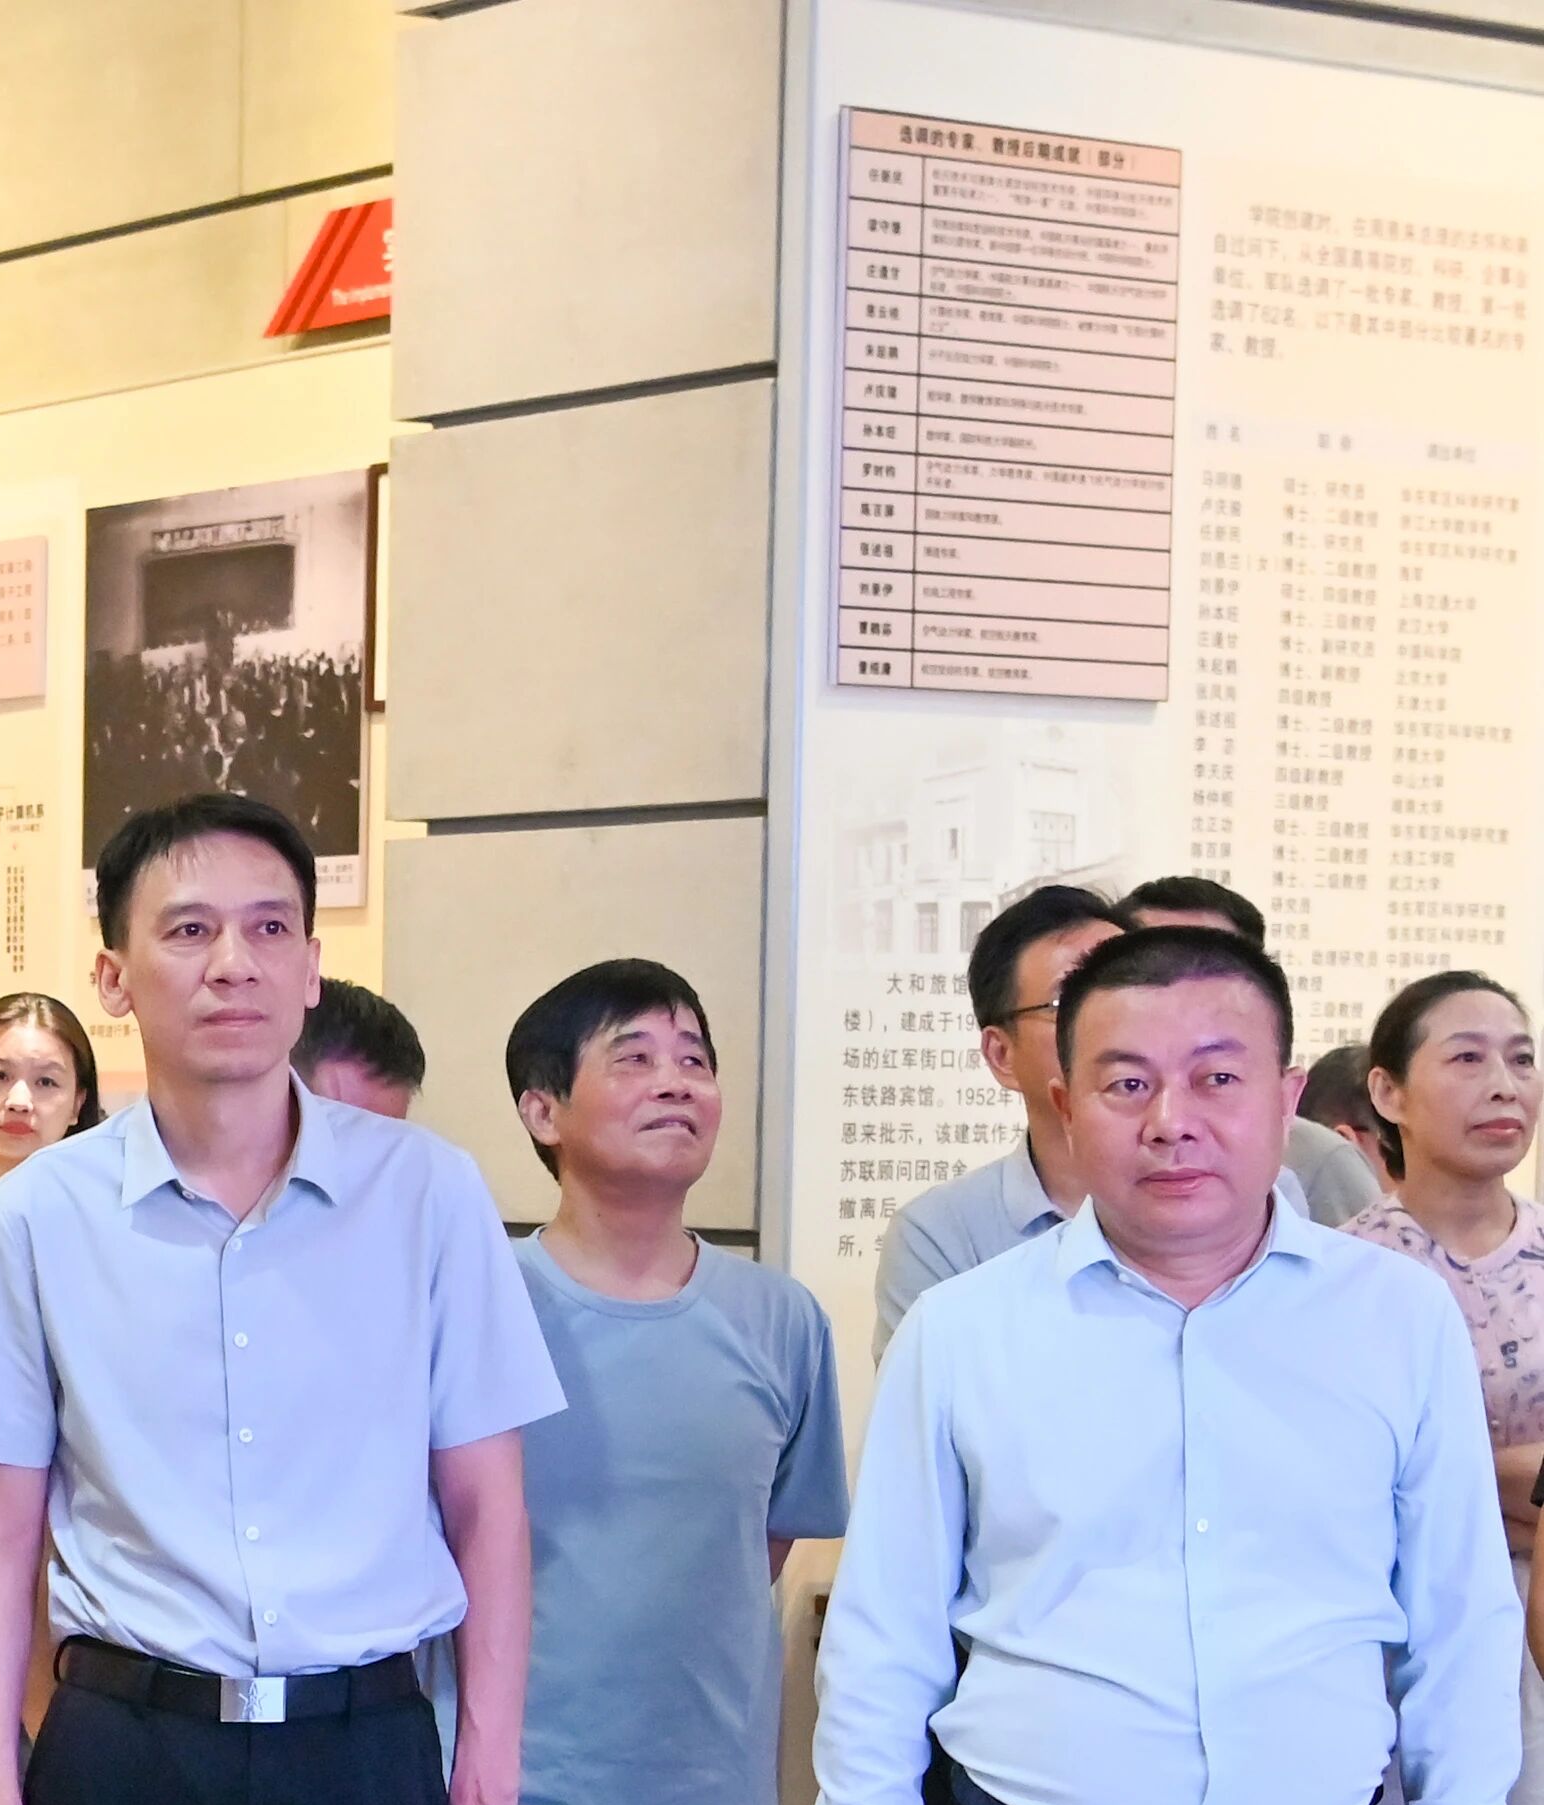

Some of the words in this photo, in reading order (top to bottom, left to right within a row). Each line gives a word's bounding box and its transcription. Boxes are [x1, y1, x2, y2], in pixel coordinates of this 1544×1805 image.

[843, 1009, 978, 1032] 楼），建成于19
[841, 1122, 1026, 1145] 恩来批示，该建筑作为
[839, 1197, 897, 1220] 撤离后
